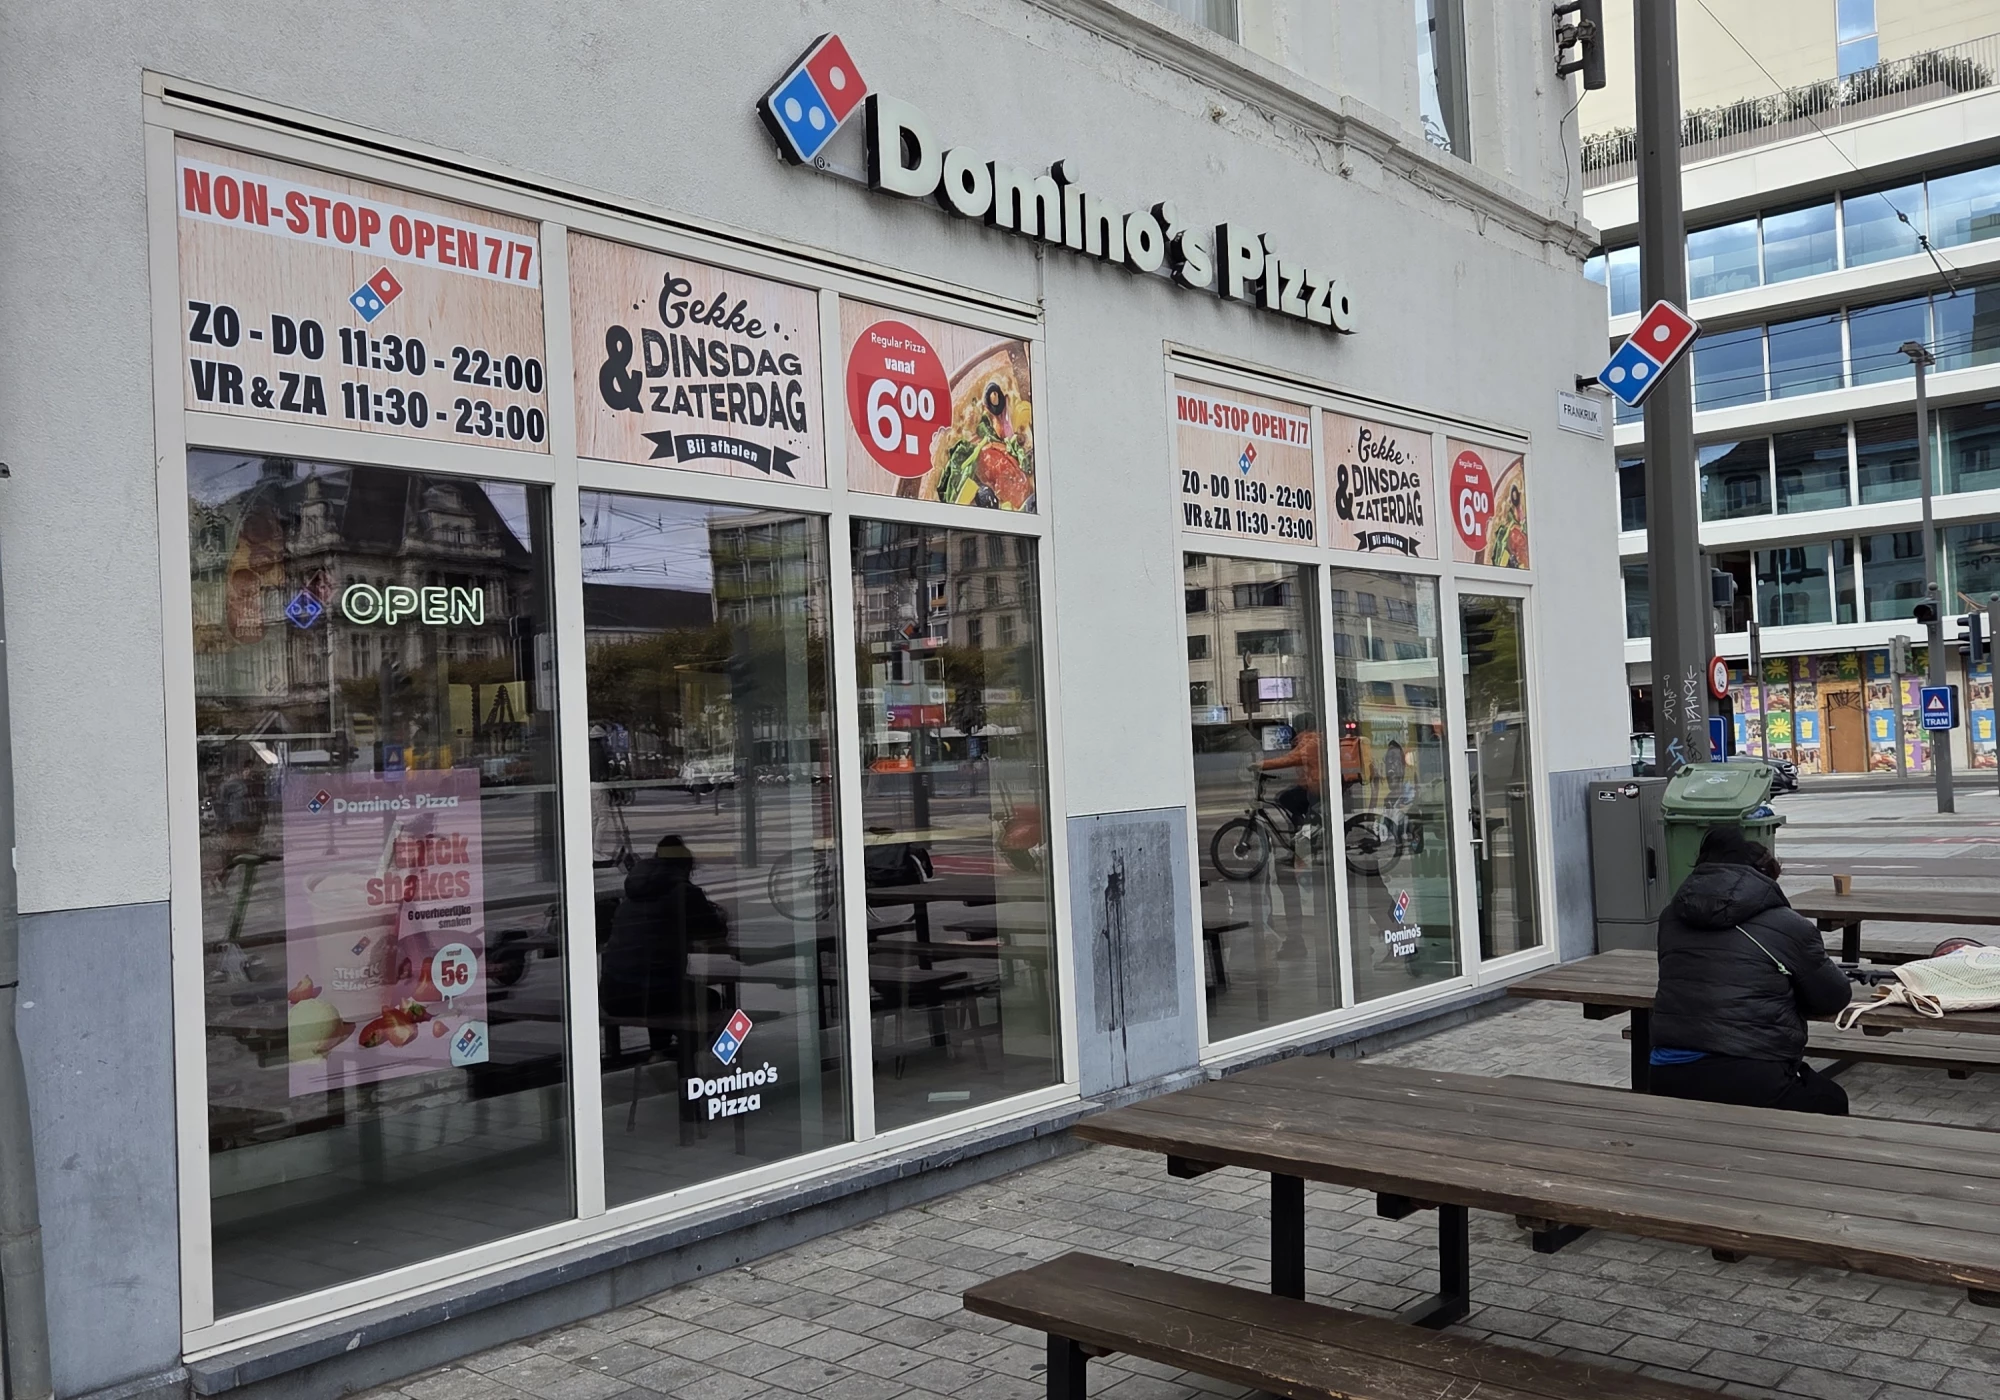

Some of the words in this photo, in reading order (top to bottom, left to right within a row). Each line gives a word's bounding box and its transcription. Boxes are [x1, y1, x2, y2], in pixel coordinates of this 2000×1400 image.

[183, 168, 381, 248] NON-STOP
[389, 214, 479, 270] OPEN
[484, 236, 533, 281] 7/7
[866, 93, 1213, 291] Domino's
[1216, 222, 1358, 335] Pizza
[659, 271, 767, 338] Gekke
[188, 301, 240, 347] ZO
[271, 314, 325, 360] DO
[339, 327, 426, 375] 11:30
[451, 346, 543, 393] 22:00
[641, 327, 802, 378] DINSDAG
[871, 332, 903, 349] Regular
[904, 339, 926, 354] Pizza
[599, 325, 644, 414] &
[884, 357, 916, 375] vanaf
[341, 382, 428, 428] 11:30
[454, 398, 545, 443] 23:00
[649, 379, 808, 433] ZATERDAG
[1177, 395, 1250, 433] NON-STOP
[1252, 411, 1287, 441] OPEN
[1289, 420, 1309, 444] 7/7
[686, 439, 706, 454] Bij
[710, 440, 758, 462] afhalen
[1358, 426, 1405, 465] Gekke
[1182, 469, 1200, 495] ZO
[1210, 474, 1230, 499] DO
[1234, 478, 1267, 504] 11:30
[1276, 485, 1312, 511] 22:00
[1335, 464, 1354, 521] &
[1351, 464, 1420, 498] DINSDAG
[1235, 510, 1268, 535] 11:30
[1278, 516, 1313, 541] 23:00
[1355, 490, 1424, 527] ZATERDAG
[341, 583, 485, 626] OPEN
[1925, 718, 1948, 726] TRAM
[333, 794, 411, 814] Domino's
[415, 793, 460, 809] Pizza
[366, 869, 471, 906] shakes
[438, 917, 471, 929] smaken
[1384, 923, 1422, 944] Domino's
[1393, 942, 1415, 958] Pizza
[440, 959, 469, 988] 5€
[687, 1061, 778, 1101] Domino's
[708, 1094, 761, 1121] Pizza
